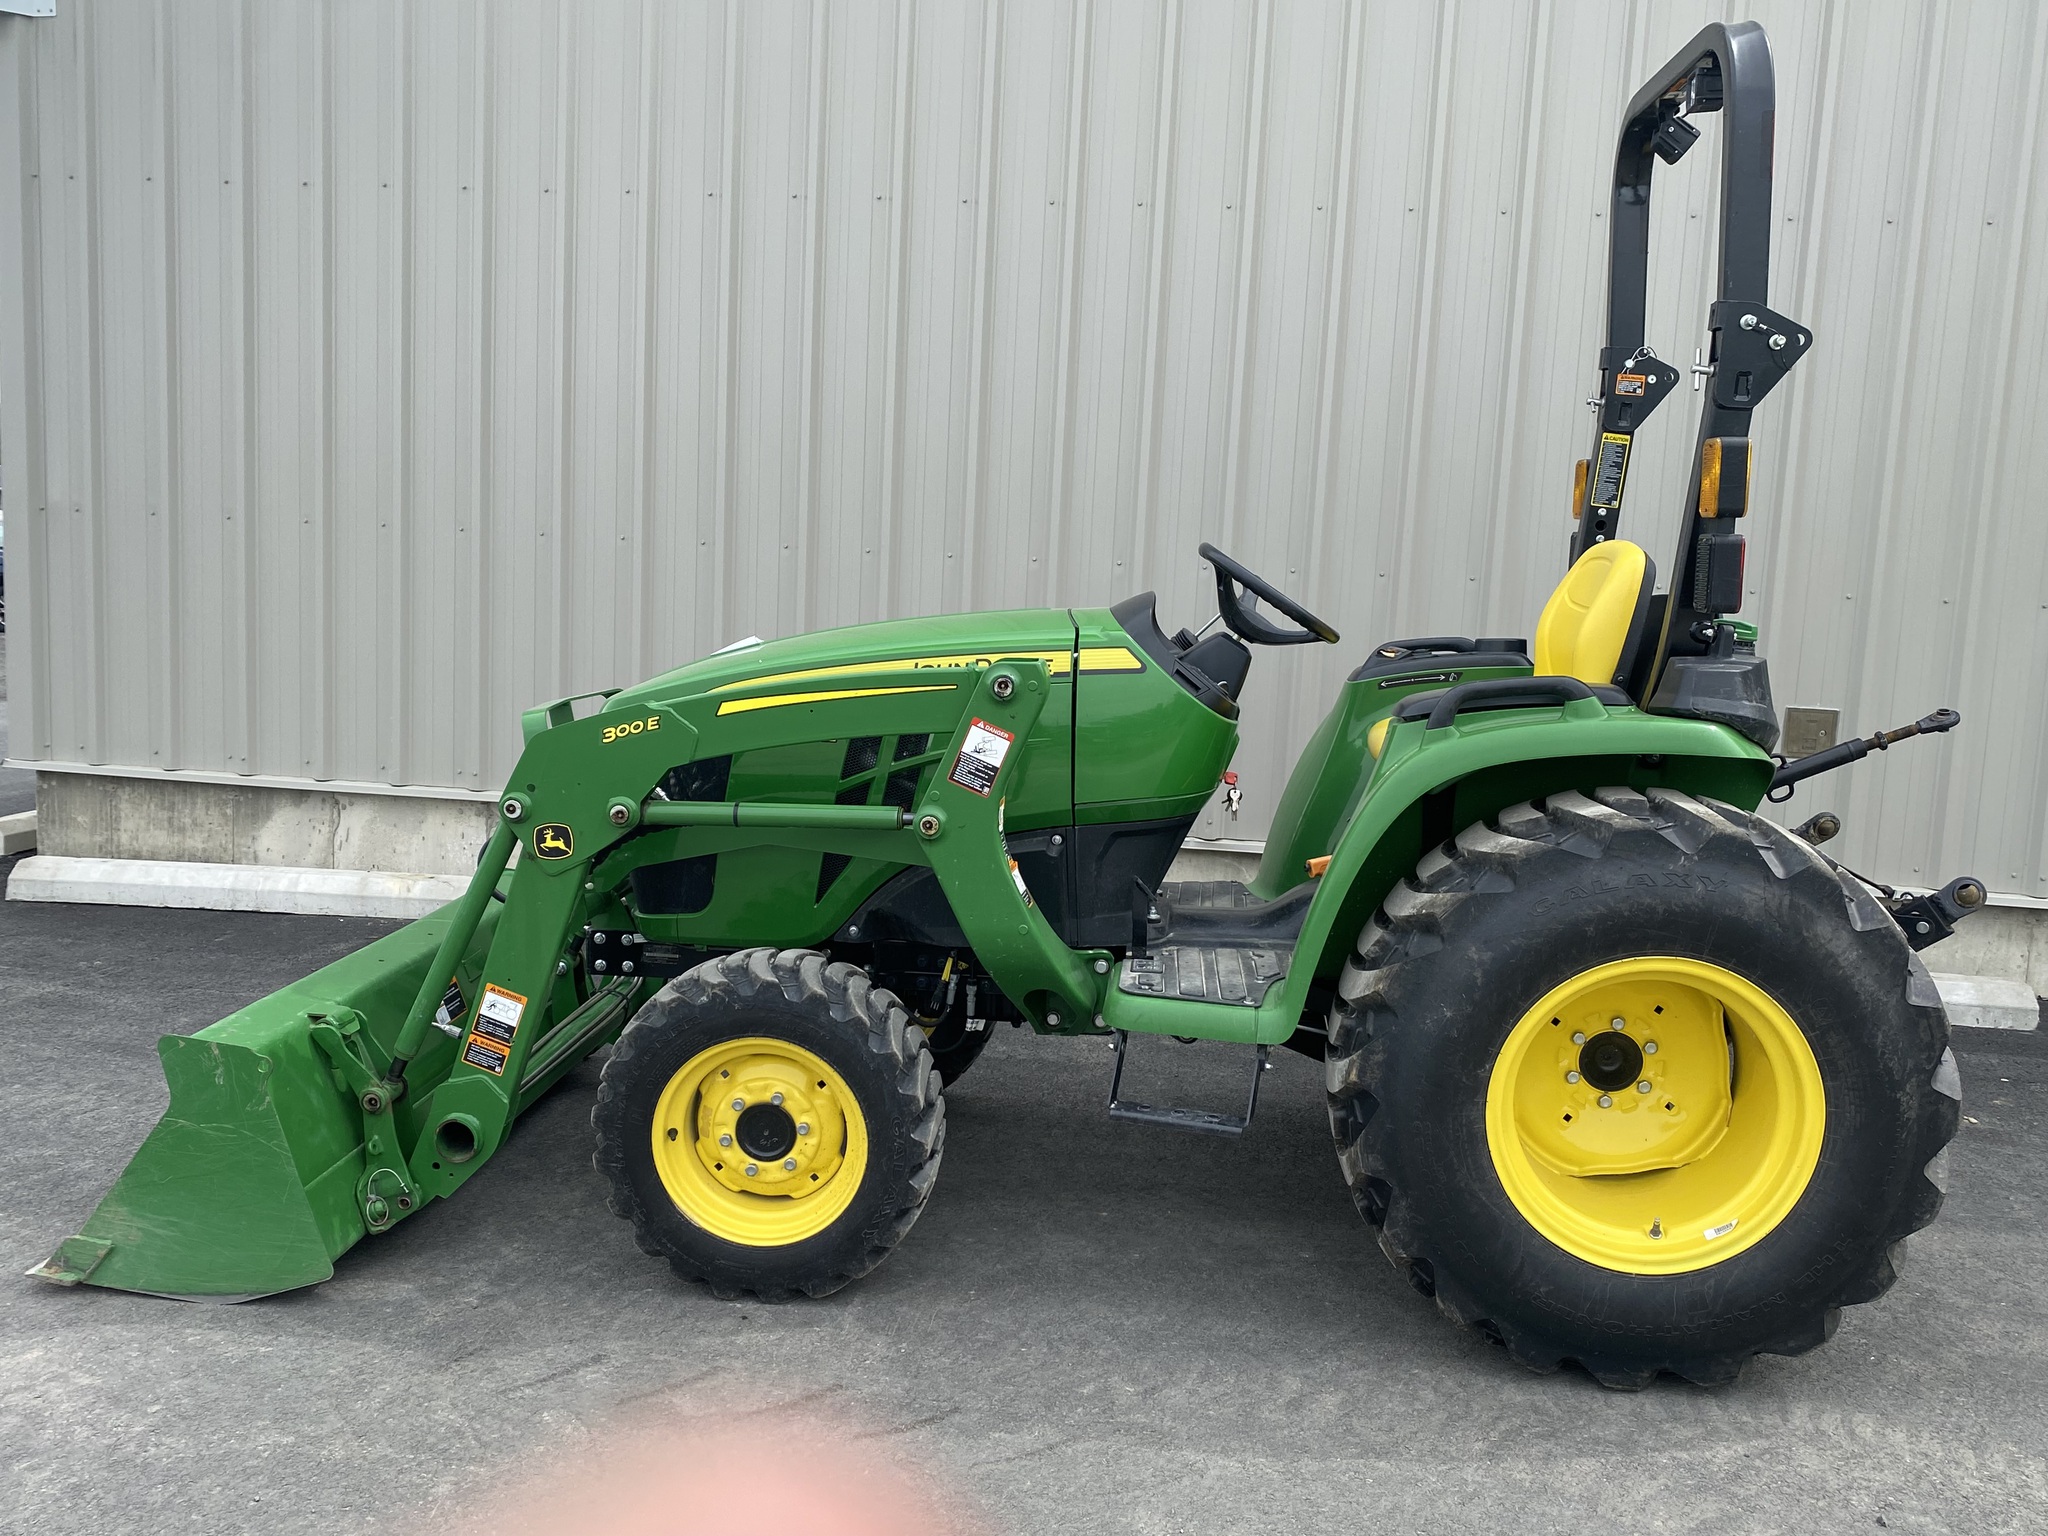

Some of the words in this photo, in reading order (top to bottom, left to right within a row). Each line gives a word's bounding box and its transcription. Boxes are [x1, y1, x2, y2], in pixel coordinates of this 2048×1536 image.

[1609, 435, 1629, 443] CAUTION
[984, 724, 1010, 739] DANGER
[1528, 871, 1729, 917] GALAXY
[496, 988, 523, 1002] WARNING
[480, 1040, 506, 1054] WARNING
